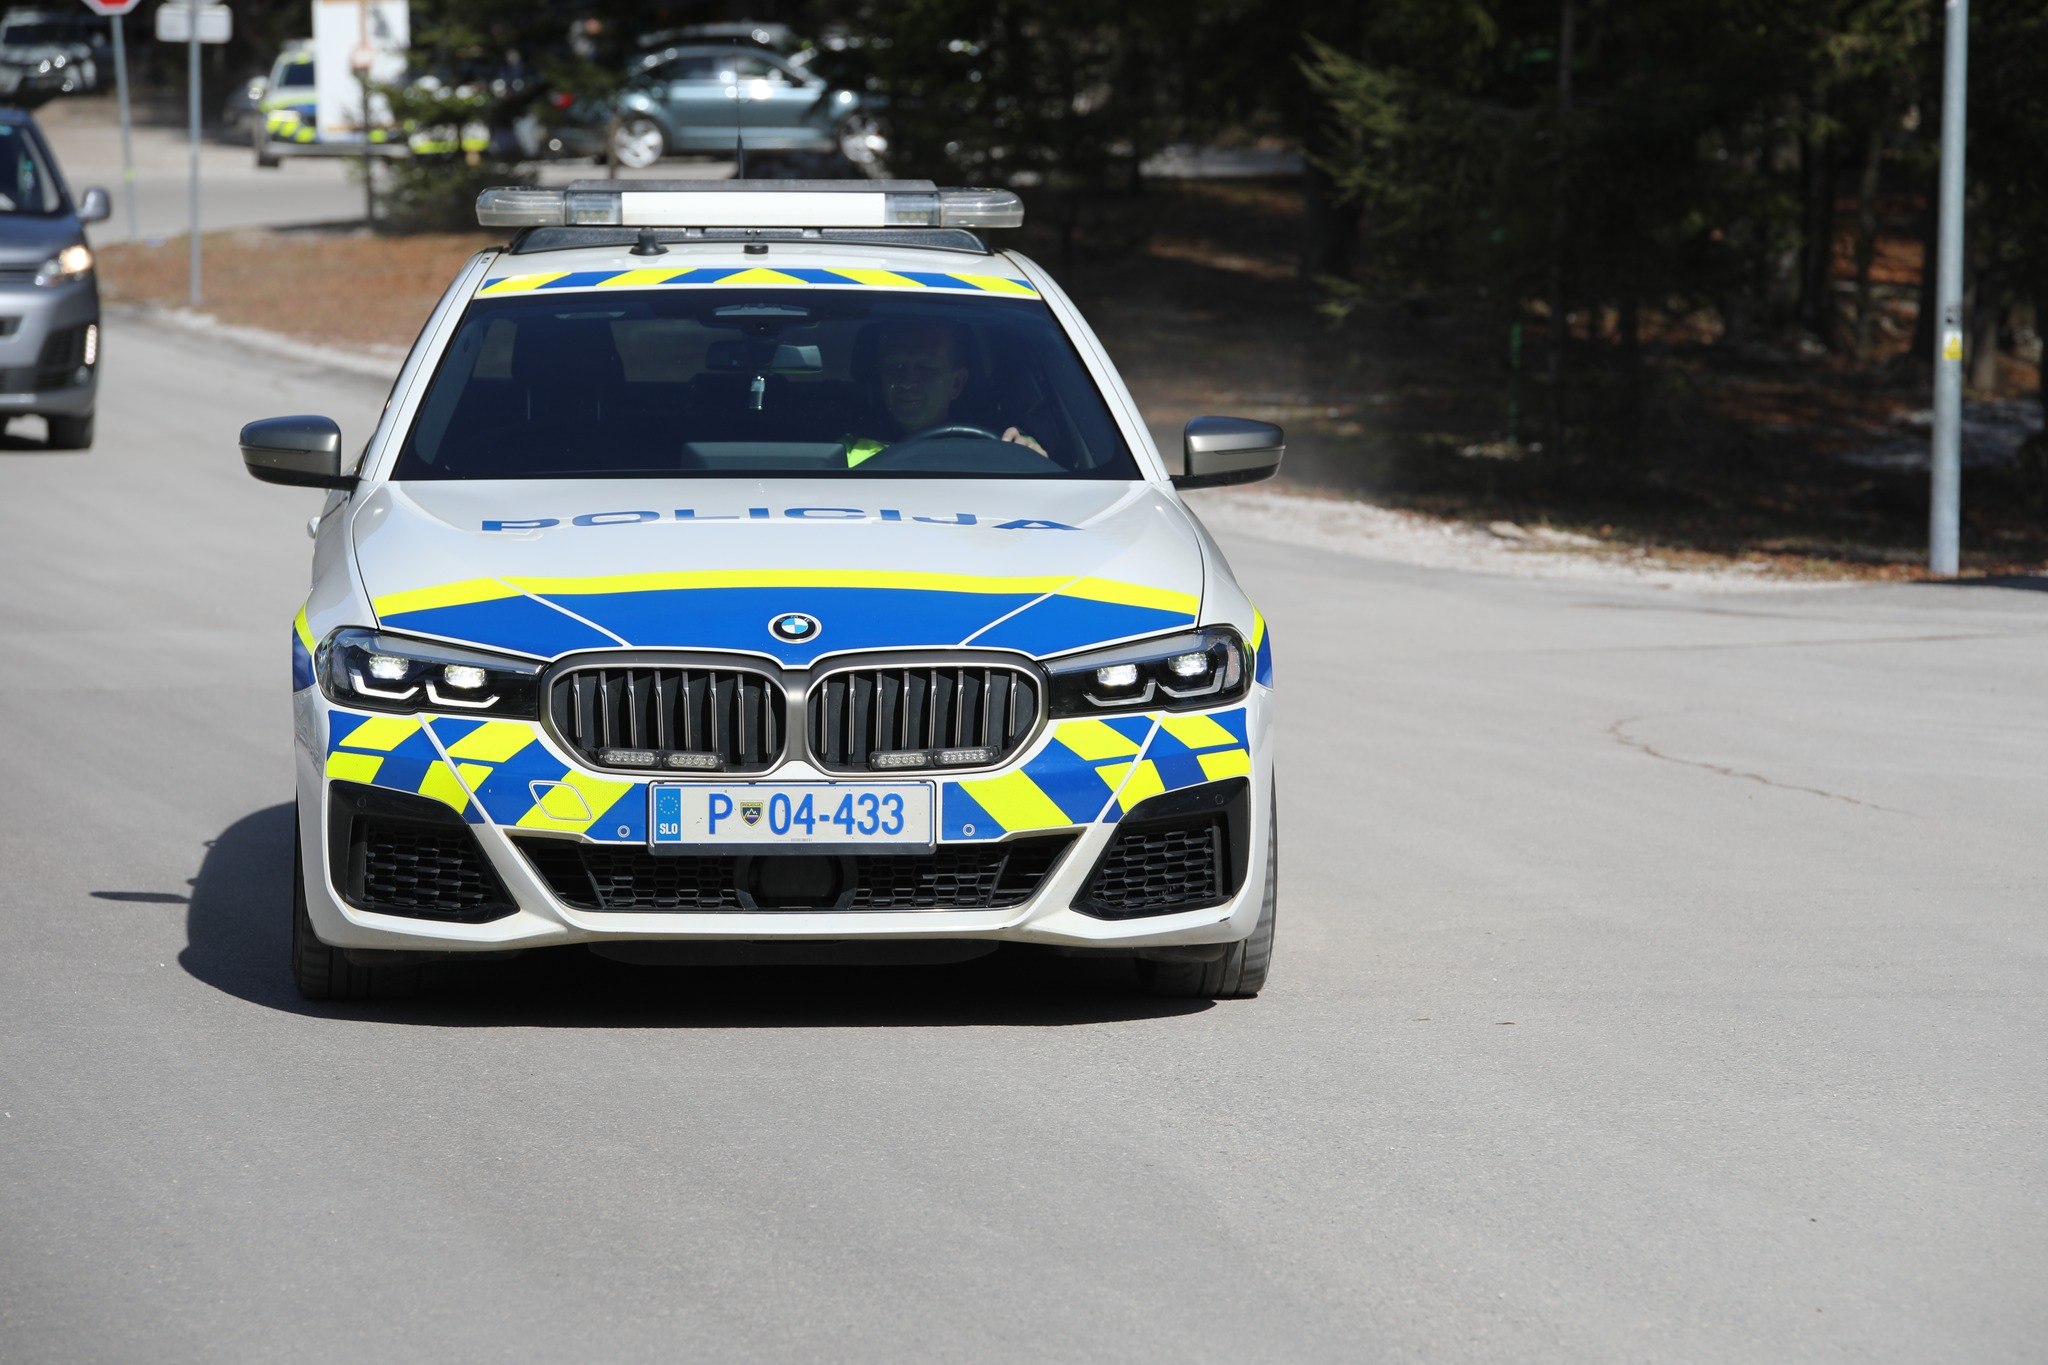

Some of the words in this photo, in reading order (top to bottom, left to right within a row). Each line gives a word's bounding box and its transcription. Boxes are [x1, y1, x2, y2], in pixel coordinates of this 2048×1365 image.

[482, 507, 1085, 531] POLICIJA
[708, 793, 733, 835] P
[768, 792, 905, 836] 04-433
[659, 823, 678, 834] SLO
